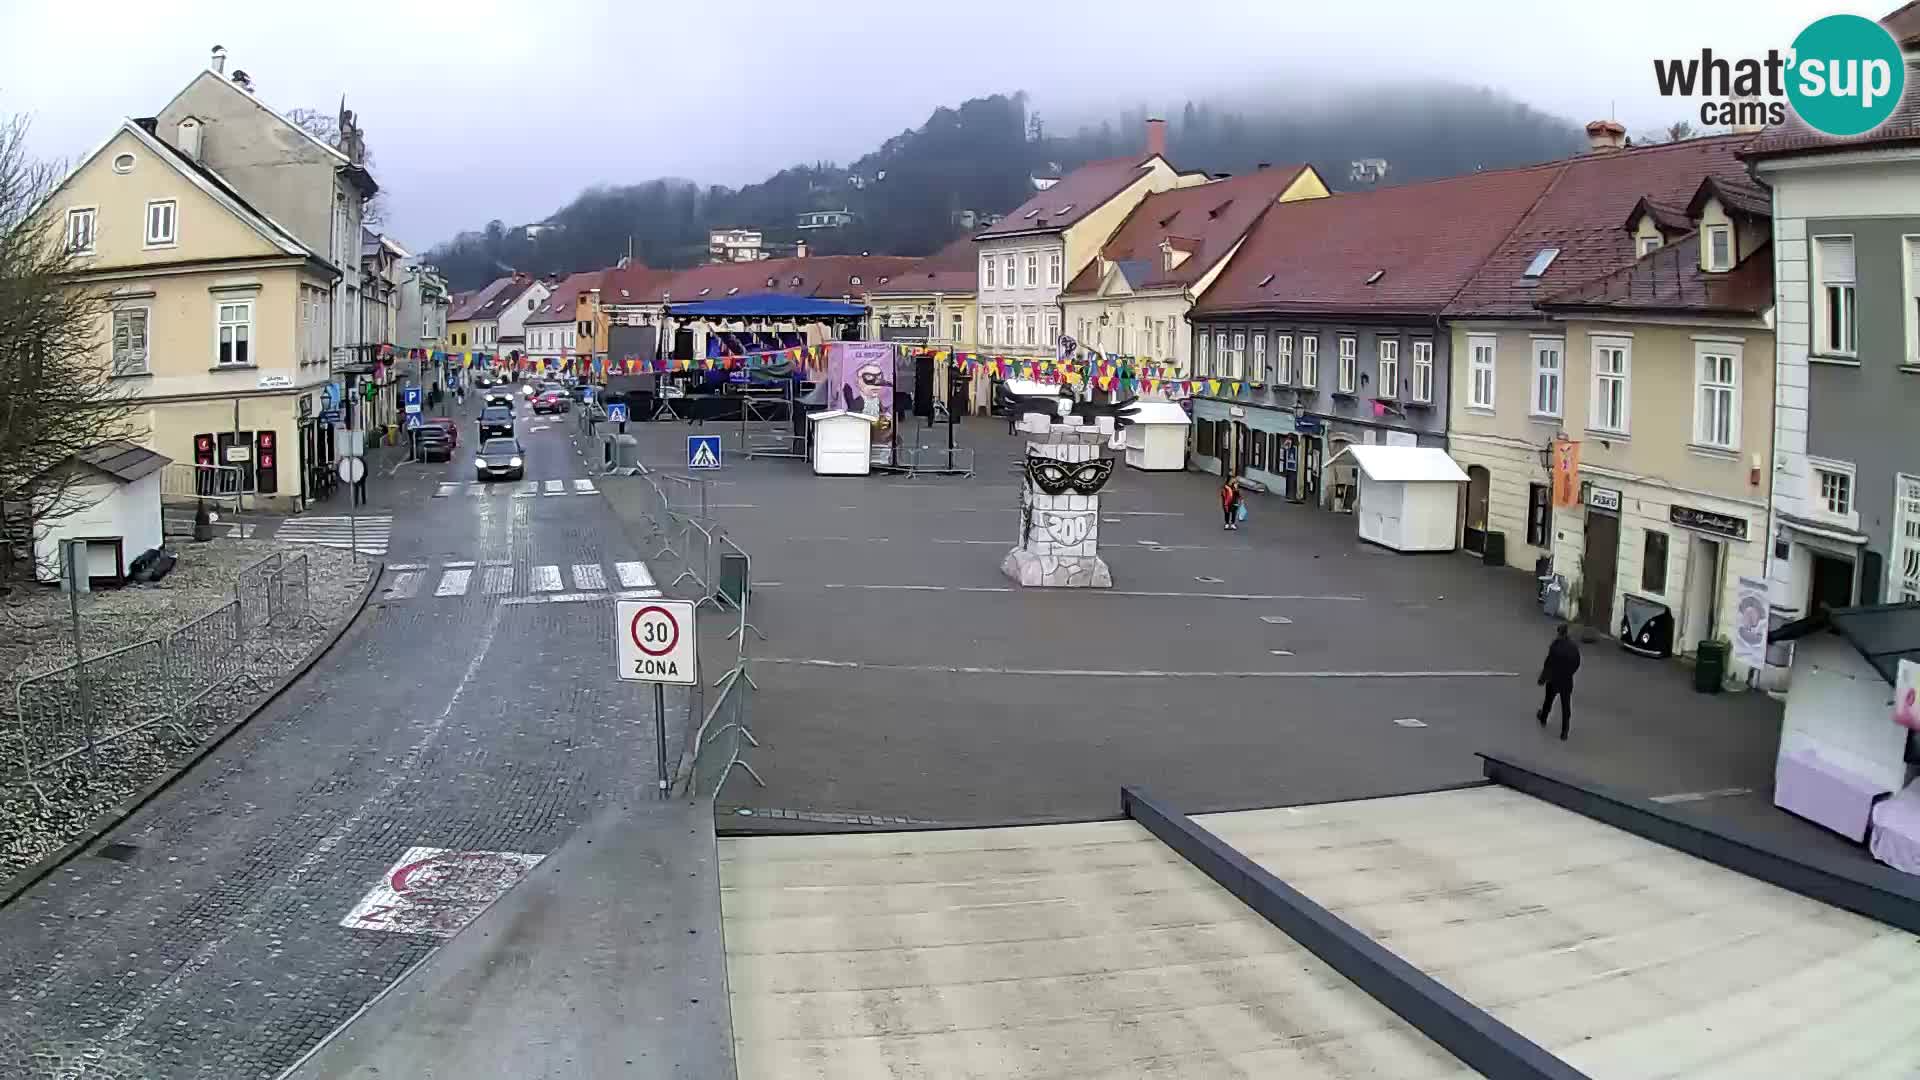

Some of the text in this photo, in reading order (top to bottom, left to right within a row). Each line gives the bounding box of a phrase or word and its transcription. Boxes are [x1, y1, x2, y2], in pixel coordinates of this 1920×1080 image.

[408, 391, 417, 402] P
[1048, 517, 1087, 545] 200
[644, 622, 668, 643] 30
[634, 659, 679, 676] ZONA
